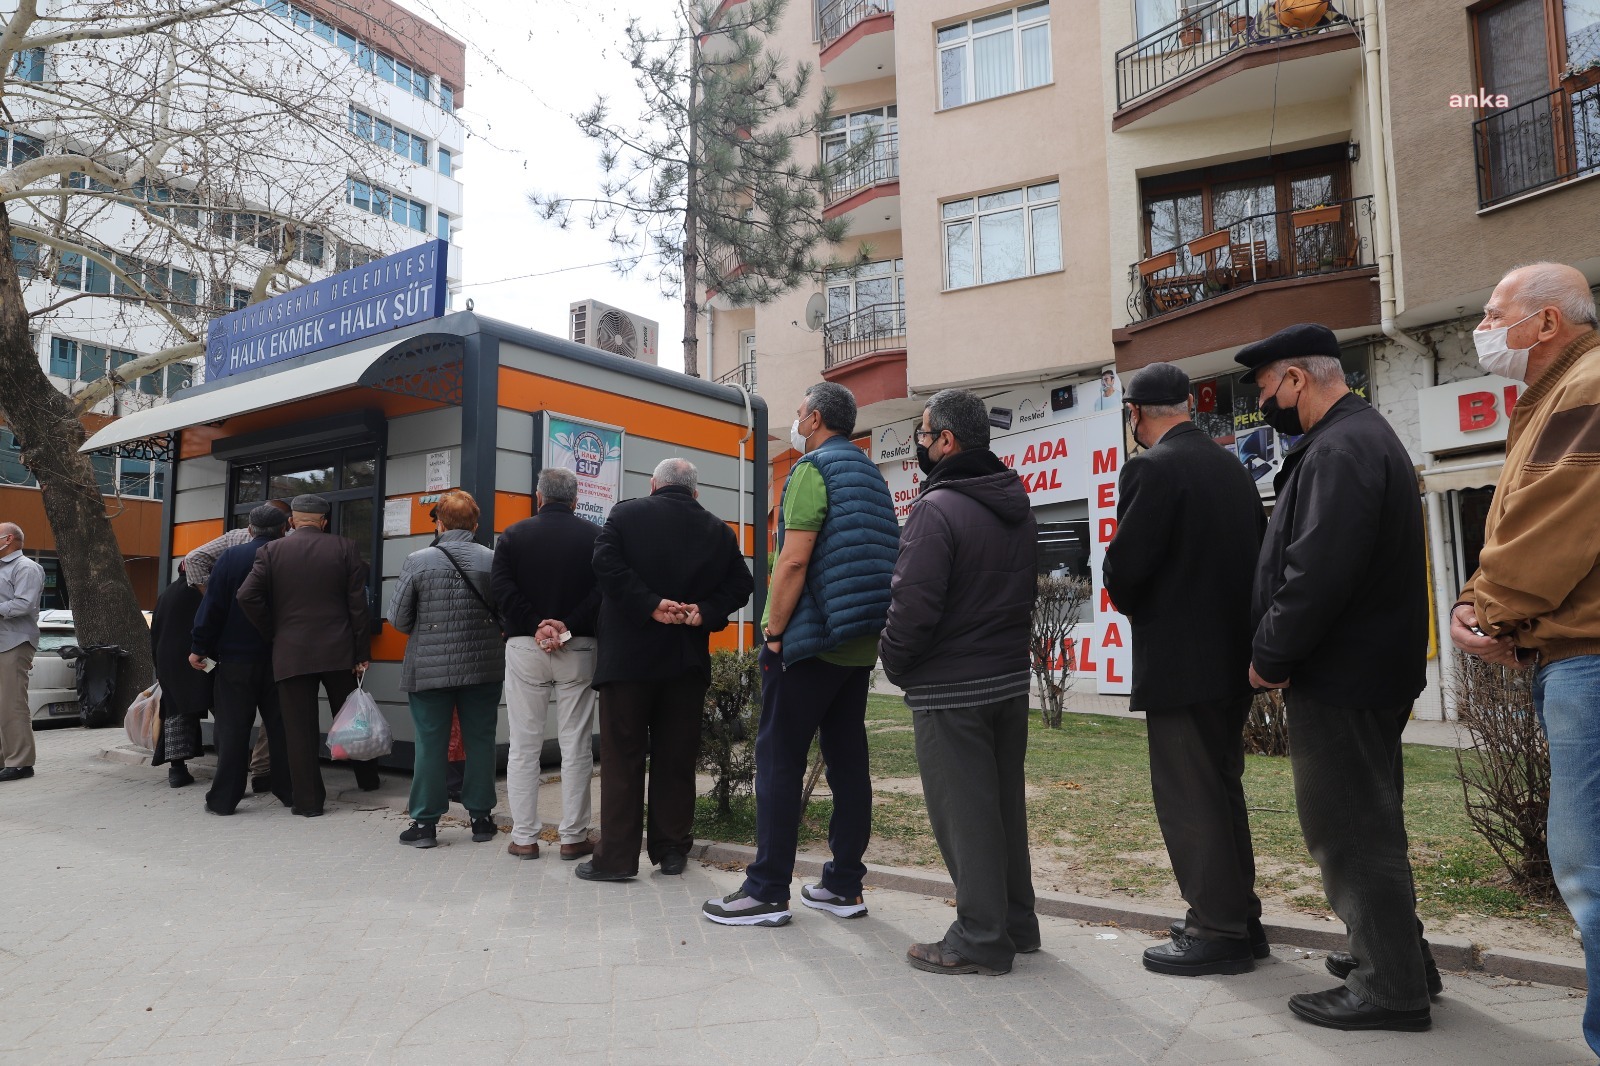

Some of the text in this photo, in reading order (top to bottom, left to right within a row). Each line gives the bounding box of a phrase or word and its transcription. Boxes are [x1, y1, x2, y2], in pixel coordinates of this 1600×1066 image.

[232, 246, 435, 335] BÜYÜKŞEHİR BELEDİYESİ
[230, 337, 266, 370] HALK
[270, 318, 324, 358] EKMEK
[340, 298, 387, 337] HALK
[393, 281, 433, 321] SÜT
[1020, 411, 1045, 423] ResMed
[581, 451, 597, 460] HALK
[881, 445, 911, 459] ResMed
[1022, 437, 1068, 466] ADA
[578, 461, 598, 475] SÜT
[1020, 468, 1062, 493] KAL
[577, 502, 604, 513] STÖRİZE
[1092, 447, 1124, 683] MEDKAL
